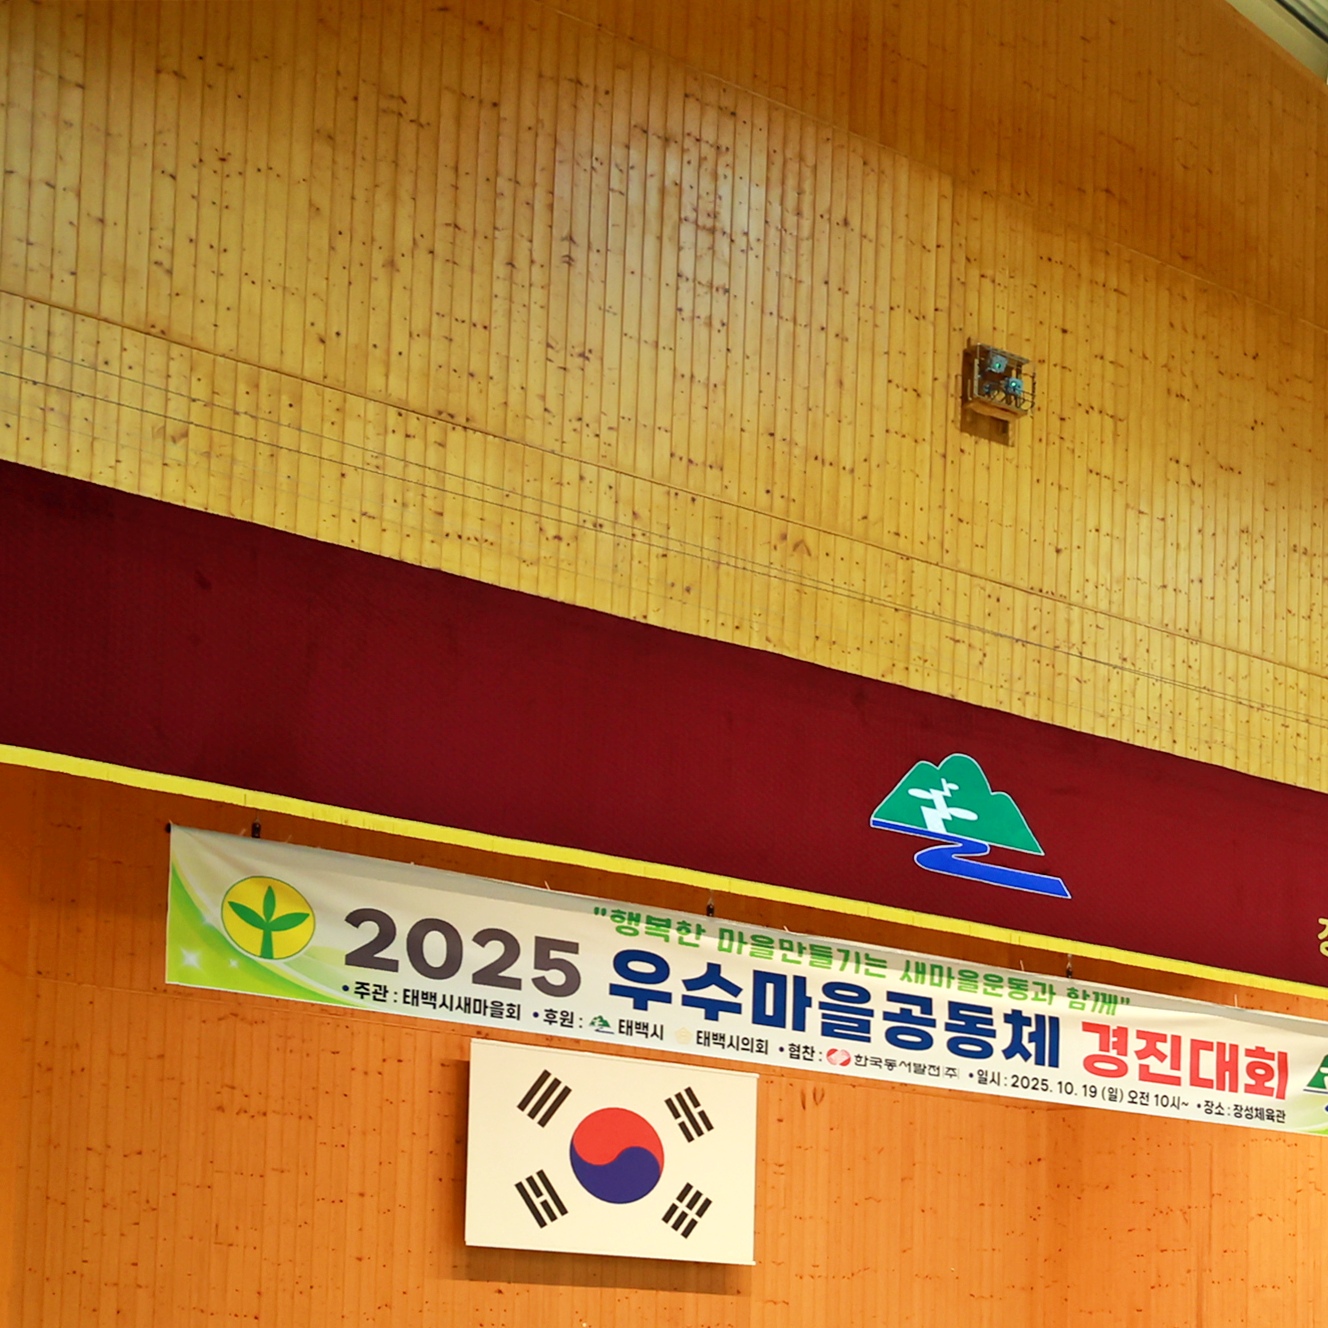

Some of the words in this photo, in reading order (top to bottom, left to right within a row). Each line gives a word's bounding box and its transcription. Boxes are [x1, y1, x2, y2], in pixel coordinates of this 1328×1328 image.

[716, 918, 887, 978] 마을만들기는
[899, 958, 1057, 1006] 새마을운동과
[343, 906, 583, 998] 2025
[609, 948, 1061, 1069] 우수마을공동체
[1080, 1019, 1290, 1101] 경진대회
[402, 986, 522, 1022] 태백시새마을회
[618, 1018, 664, 1042] 태백시
[696, 1028, 769, 1055] 태백시의회
[1127, 1087, 1152, 1107] 오전
[1233, 1102, 1288, 1125] 장성체육관
